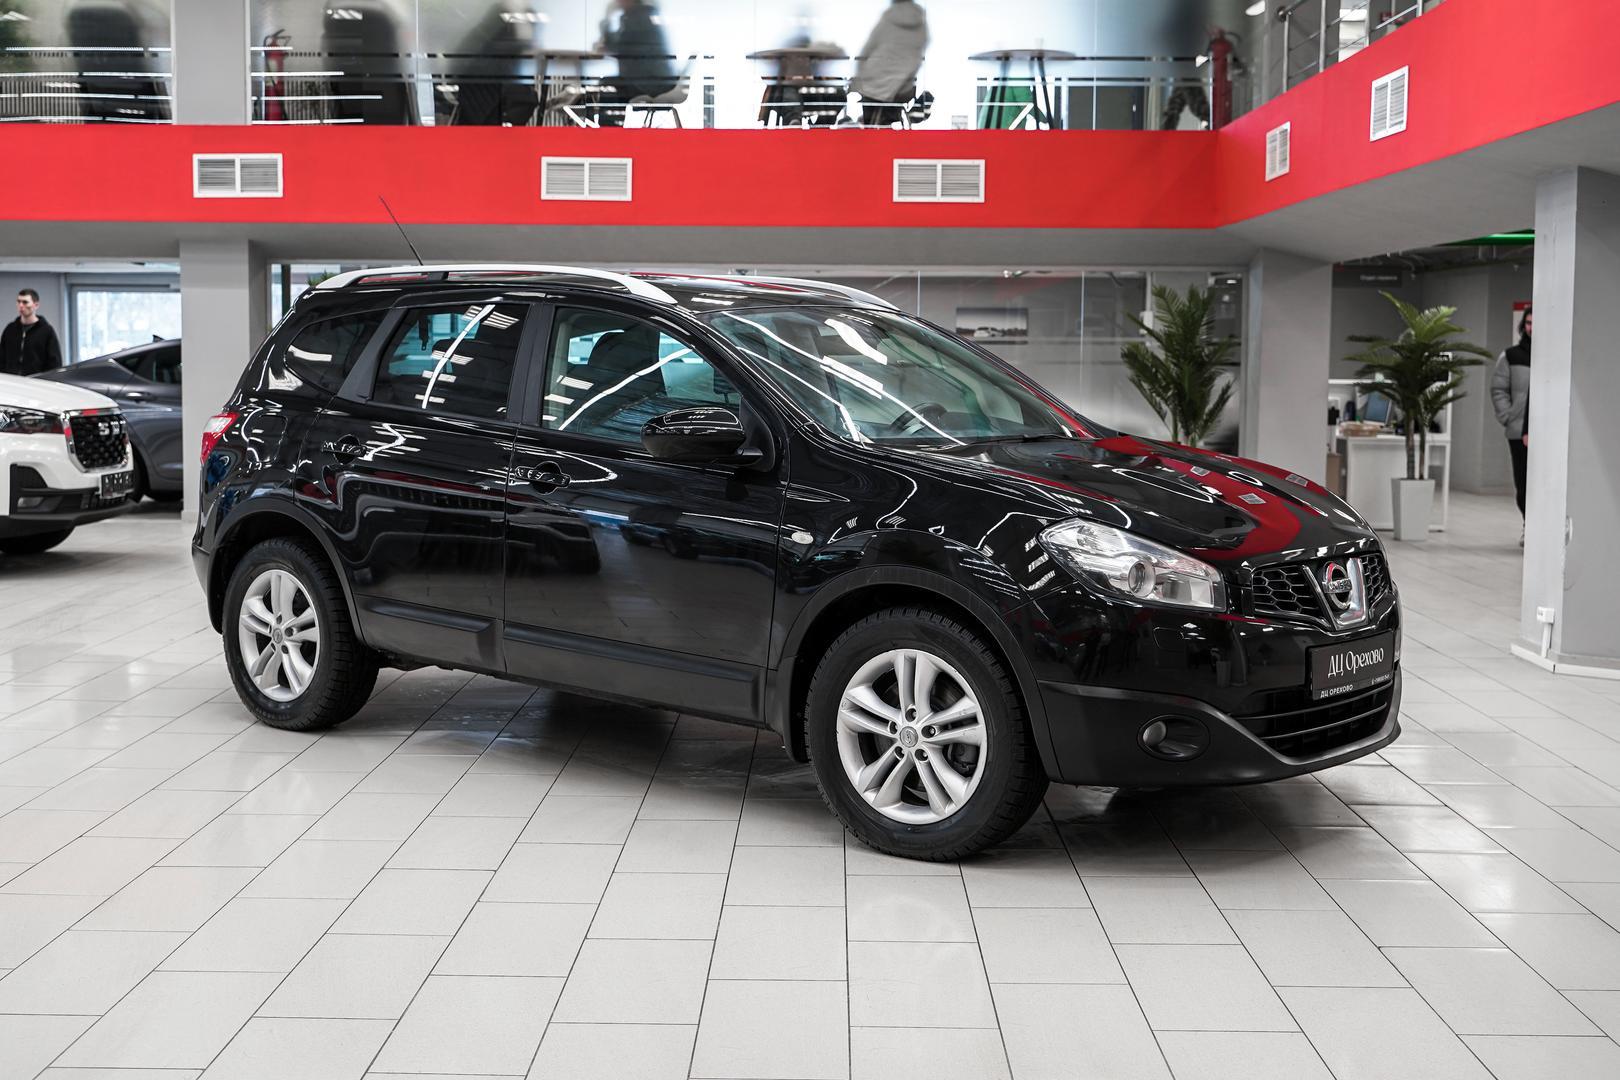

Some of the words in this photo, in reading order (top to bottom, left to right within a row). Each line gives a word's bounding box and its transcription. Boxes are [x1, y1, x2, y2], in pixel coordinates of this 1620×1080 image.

[1328, 653, 1344, 678] ДЦ
[1345, 648, 1384, 674] Орехово
[1320, 690, 1329, 699] ДЦ
[1329, 684, 1354, 696] ОРЕХОВО
